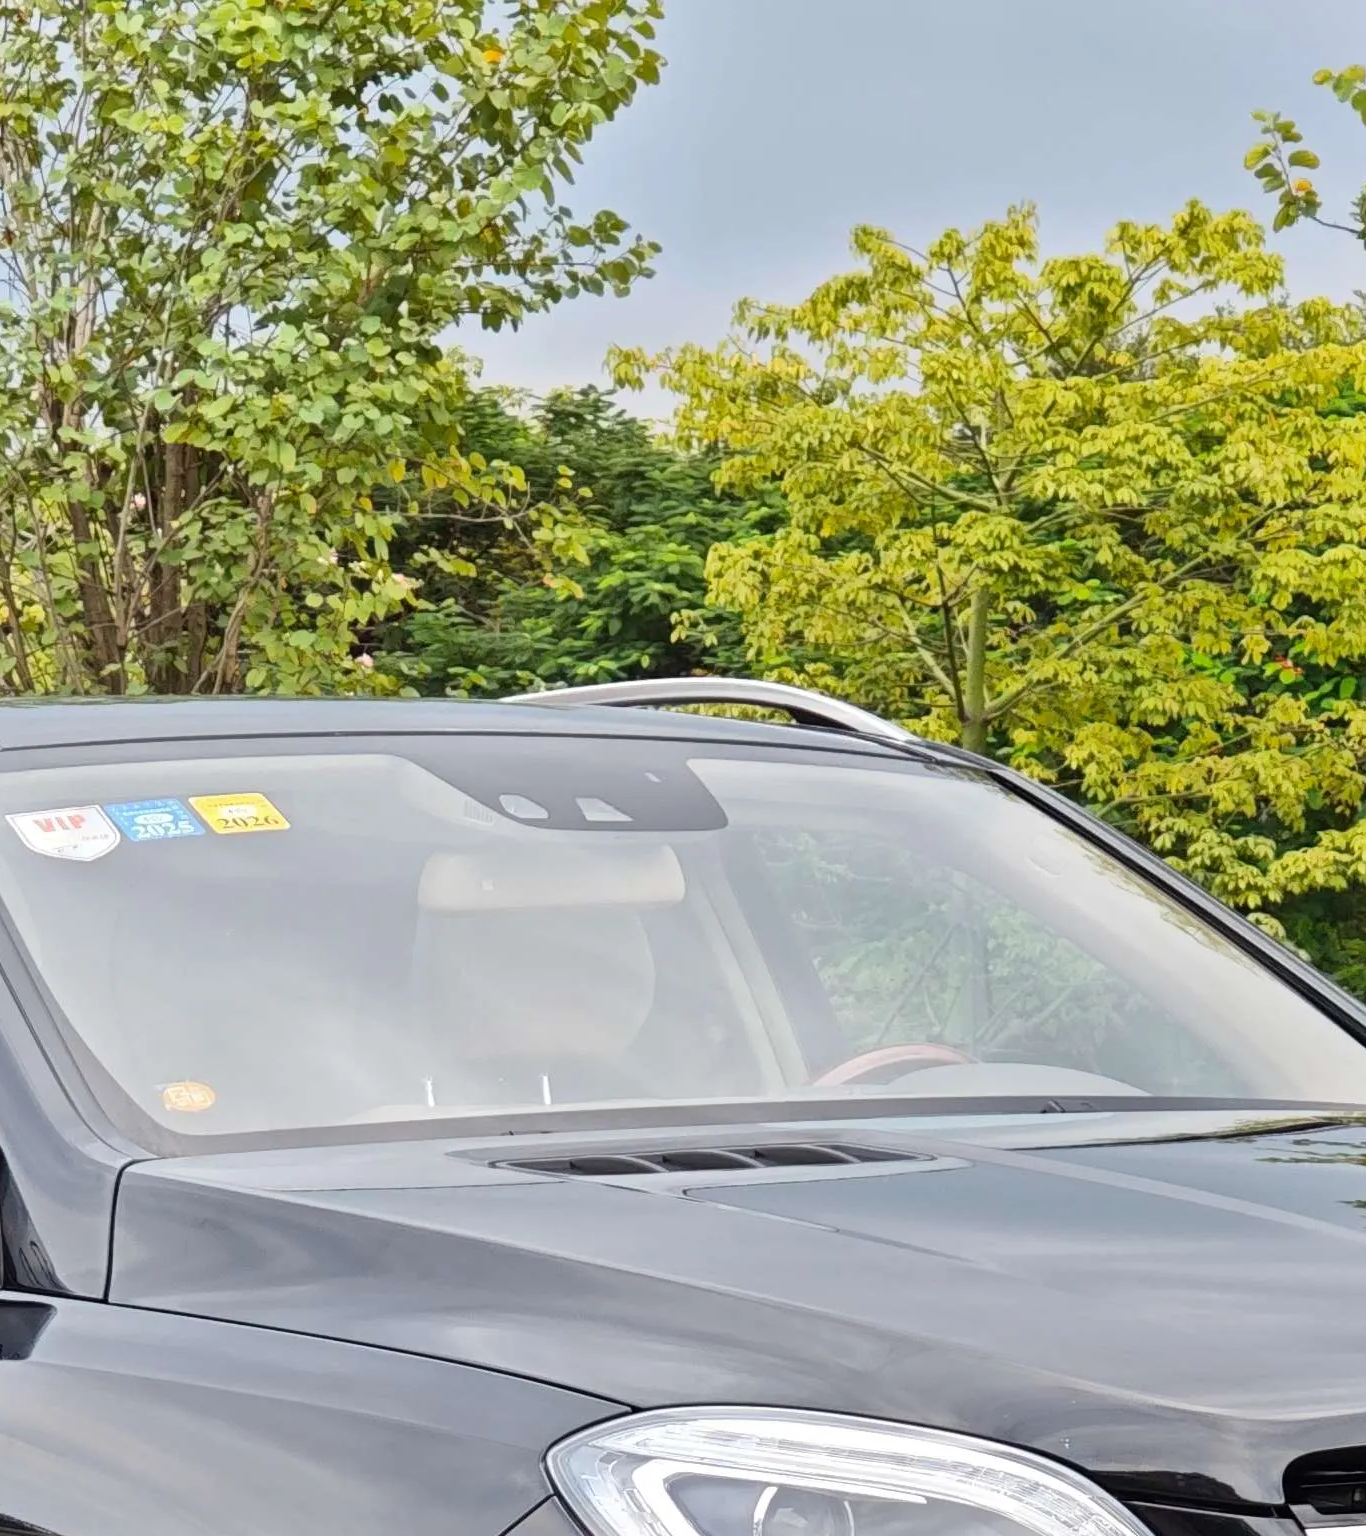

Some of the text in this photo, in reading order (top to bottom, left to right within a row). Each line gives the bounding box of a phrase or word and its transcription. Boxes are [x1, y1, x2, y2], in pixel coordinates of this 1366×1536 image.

[33, 814, 87, 833] VIP
[131, 820, 195, 841] 2025
[216, 815, 279, 829] 2026
